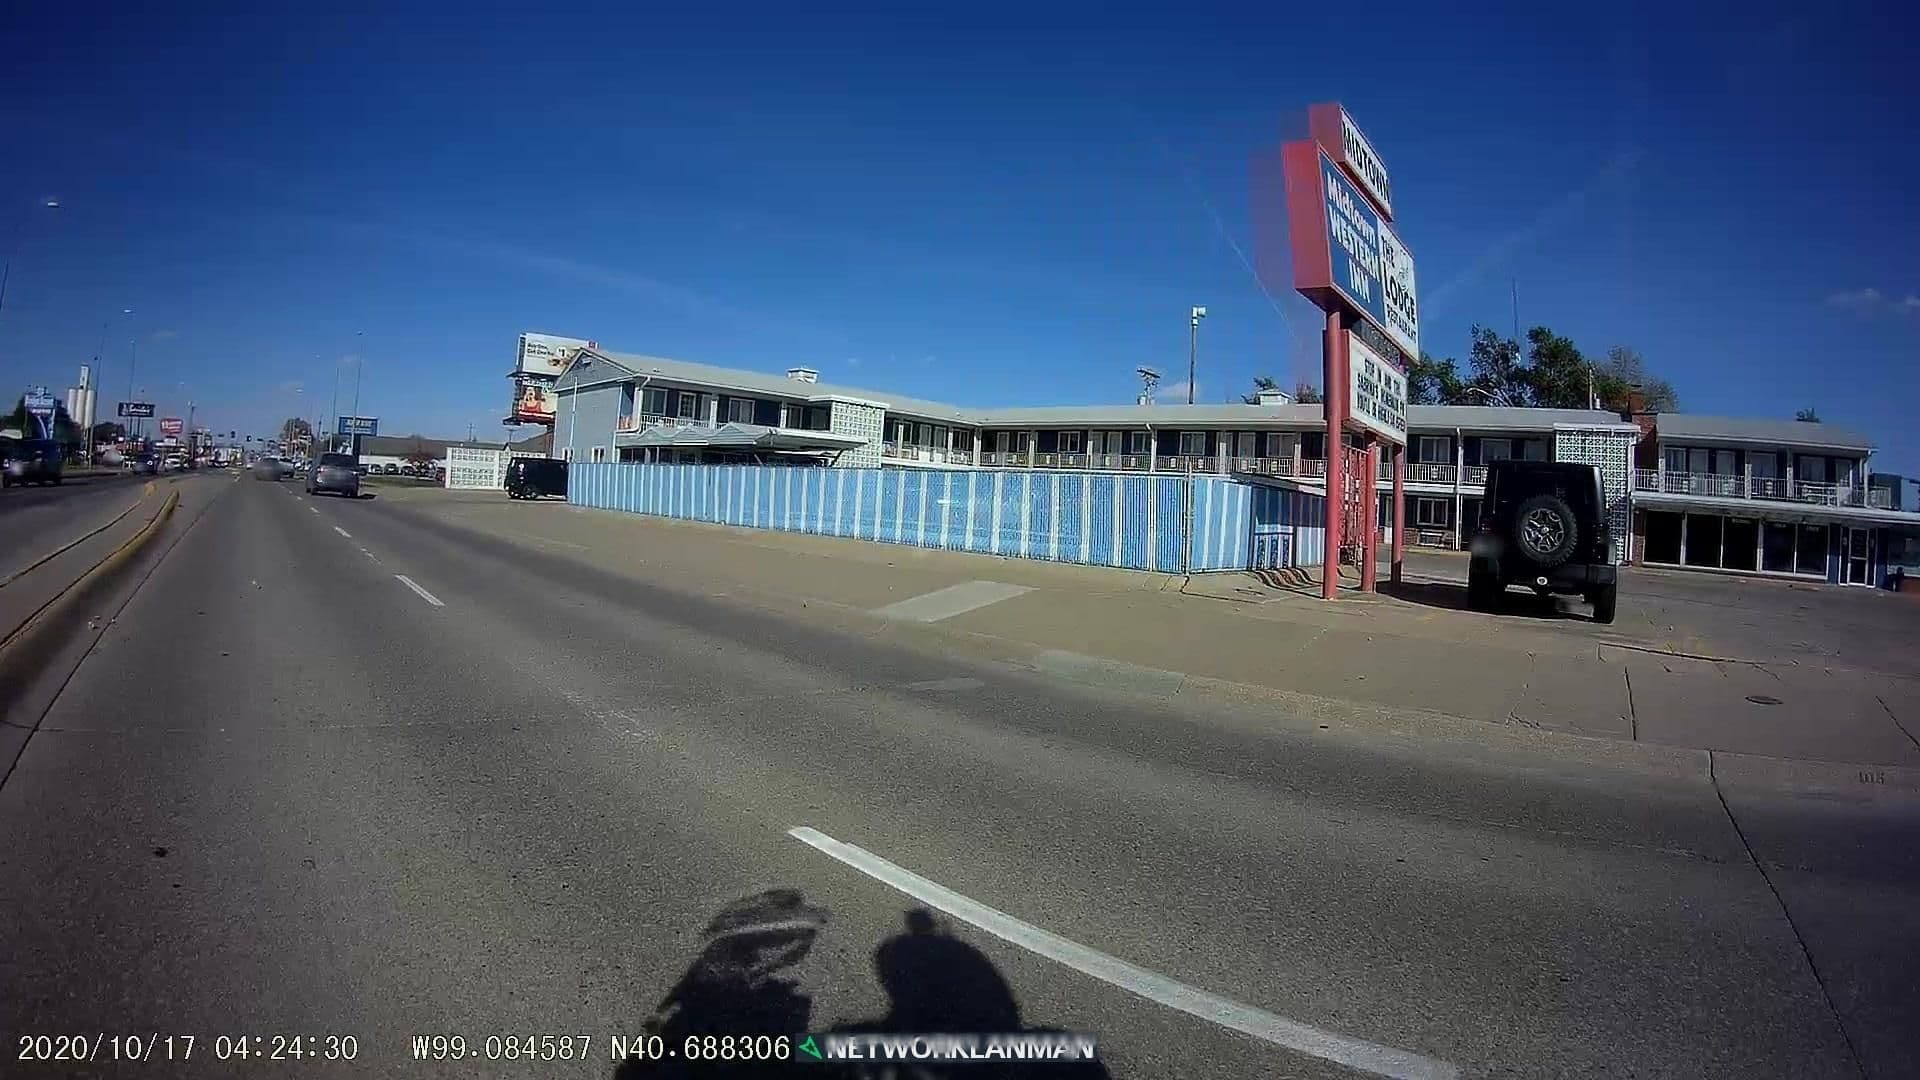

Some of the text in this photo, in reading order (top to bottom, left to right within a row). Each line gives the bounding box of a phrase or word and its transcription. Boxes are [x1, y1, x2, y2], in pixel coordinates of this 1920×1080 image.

[1342, 120, 1391, 204] MIDTOWN
[1326, 171, 1376, 248] Midtown
[1327, 203, 1380, 282] WESTERN
[1348, 258, 1370, 303] INN
[1383, 261, 1416, 325] LODGE
